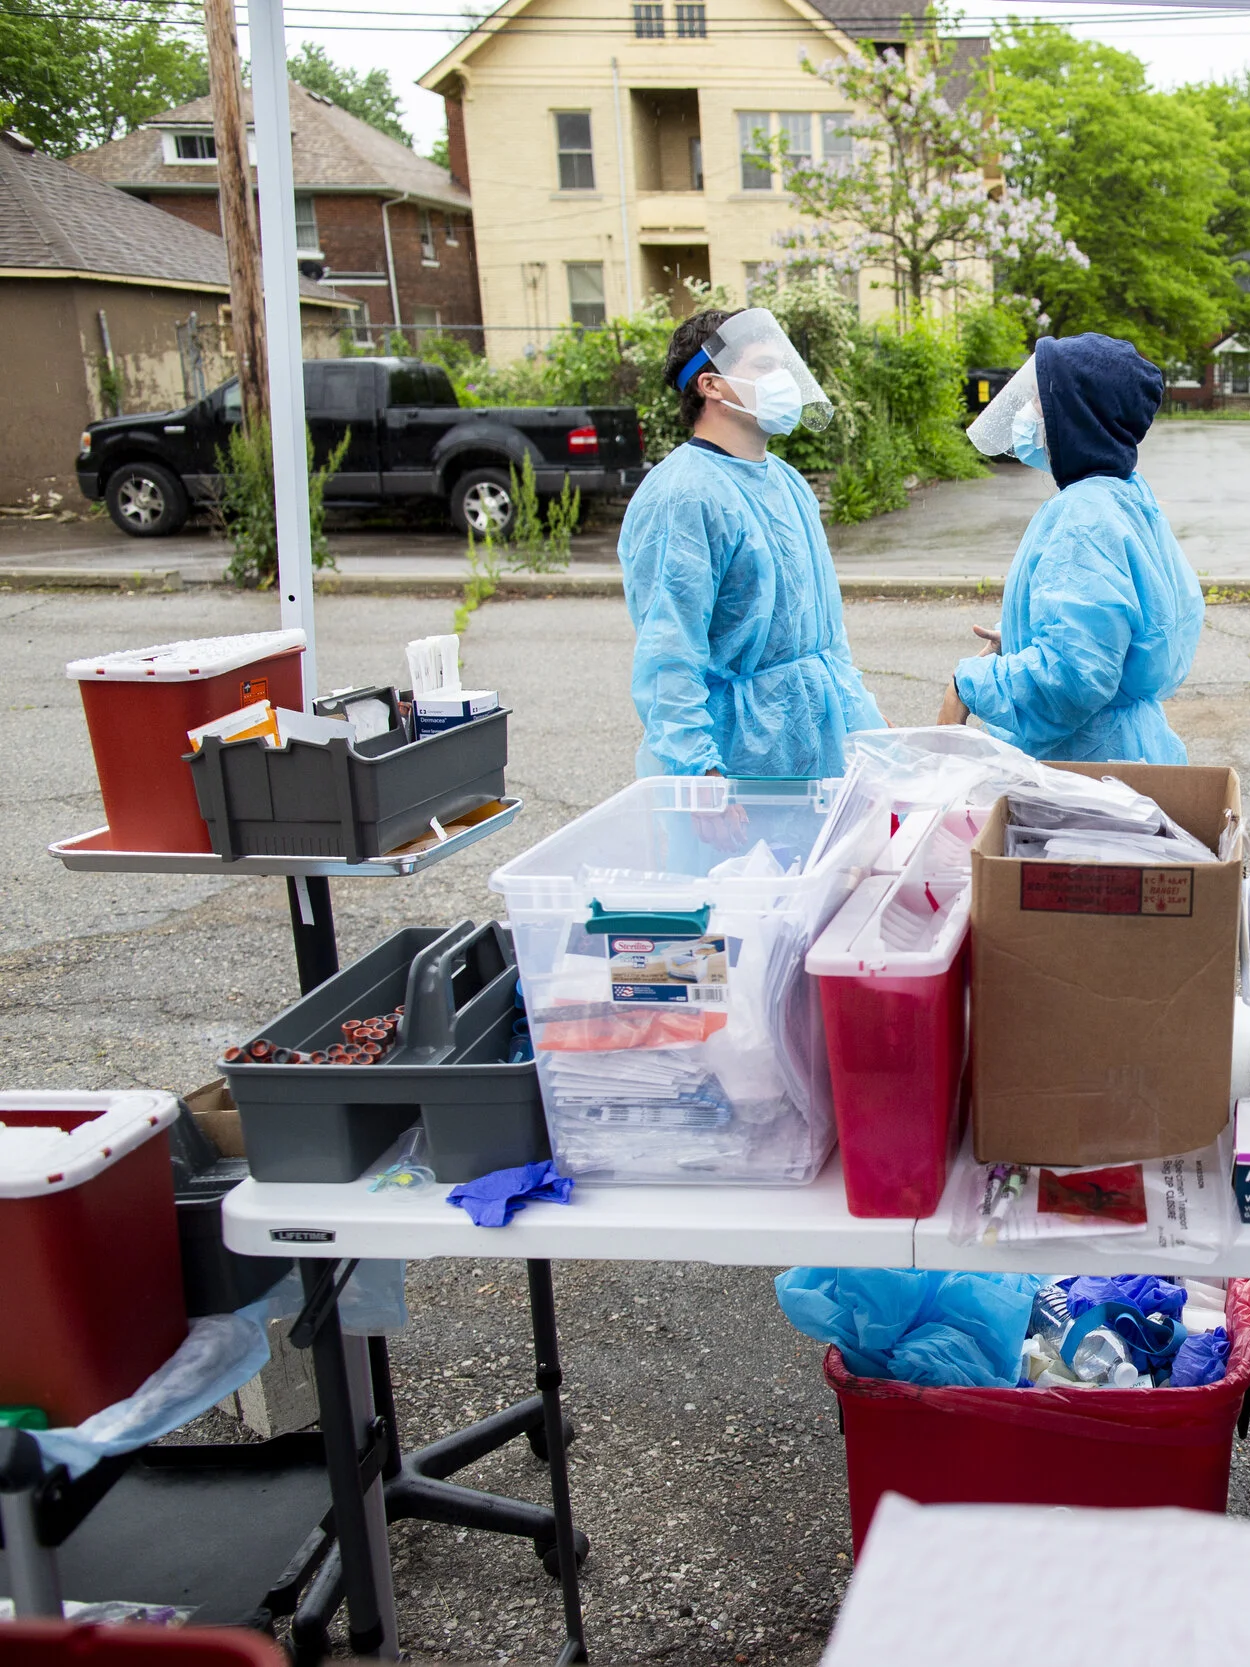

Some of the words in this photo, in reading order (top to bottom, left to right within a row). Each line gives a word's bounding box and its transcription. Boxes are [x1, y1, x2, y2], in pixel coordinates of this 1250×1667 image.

[618, 941, 651, 950] Sterilite
[1161, 1160, 1173, 1175] Bag
[1164, 1176, 1174, 1188] ZIP
[1174, 1159, 1185, 1197] Specimen
[1165, 1190, 1176, 1220] CLOSURE
[1178, 1198, 1188, 1230] Transport
[278, 1232, 328, 1241] LIFETIME
